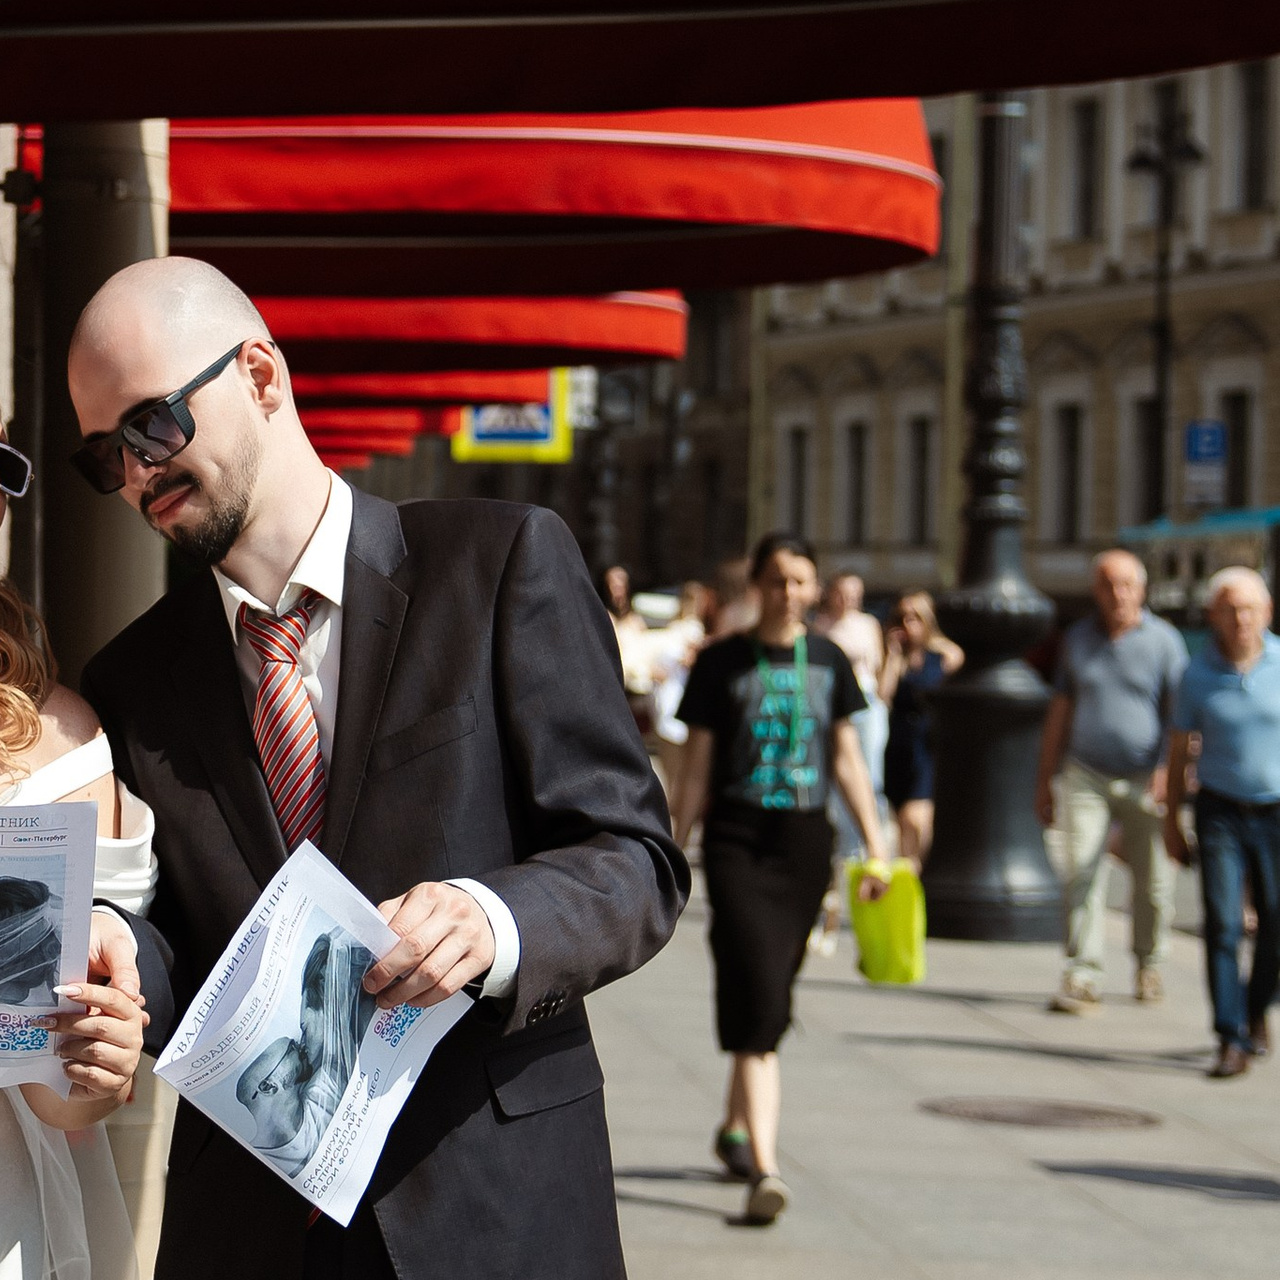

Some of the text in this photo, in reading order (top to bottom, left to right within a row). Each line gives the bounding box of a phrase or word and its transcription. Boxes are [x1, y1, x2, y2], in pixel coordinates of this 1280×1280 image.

[13, 833, 68, 842] Санкт-Петербург
[171, 873, 290, 1062] СВАДЕБНЫЙ ВЕСТНИК
[191, 914, 288, 1069] СВАДЕБНЫЙ ВЕСТНИК
[303, 1070, 367, 1189] СКАНИРУЙ QR-КОД
[309, 1110, 358, 1195] И ПРИСЫЛАЙ
[317, 1067, 382, 1200] СВОИ ФОТО И ВИДЕО!
